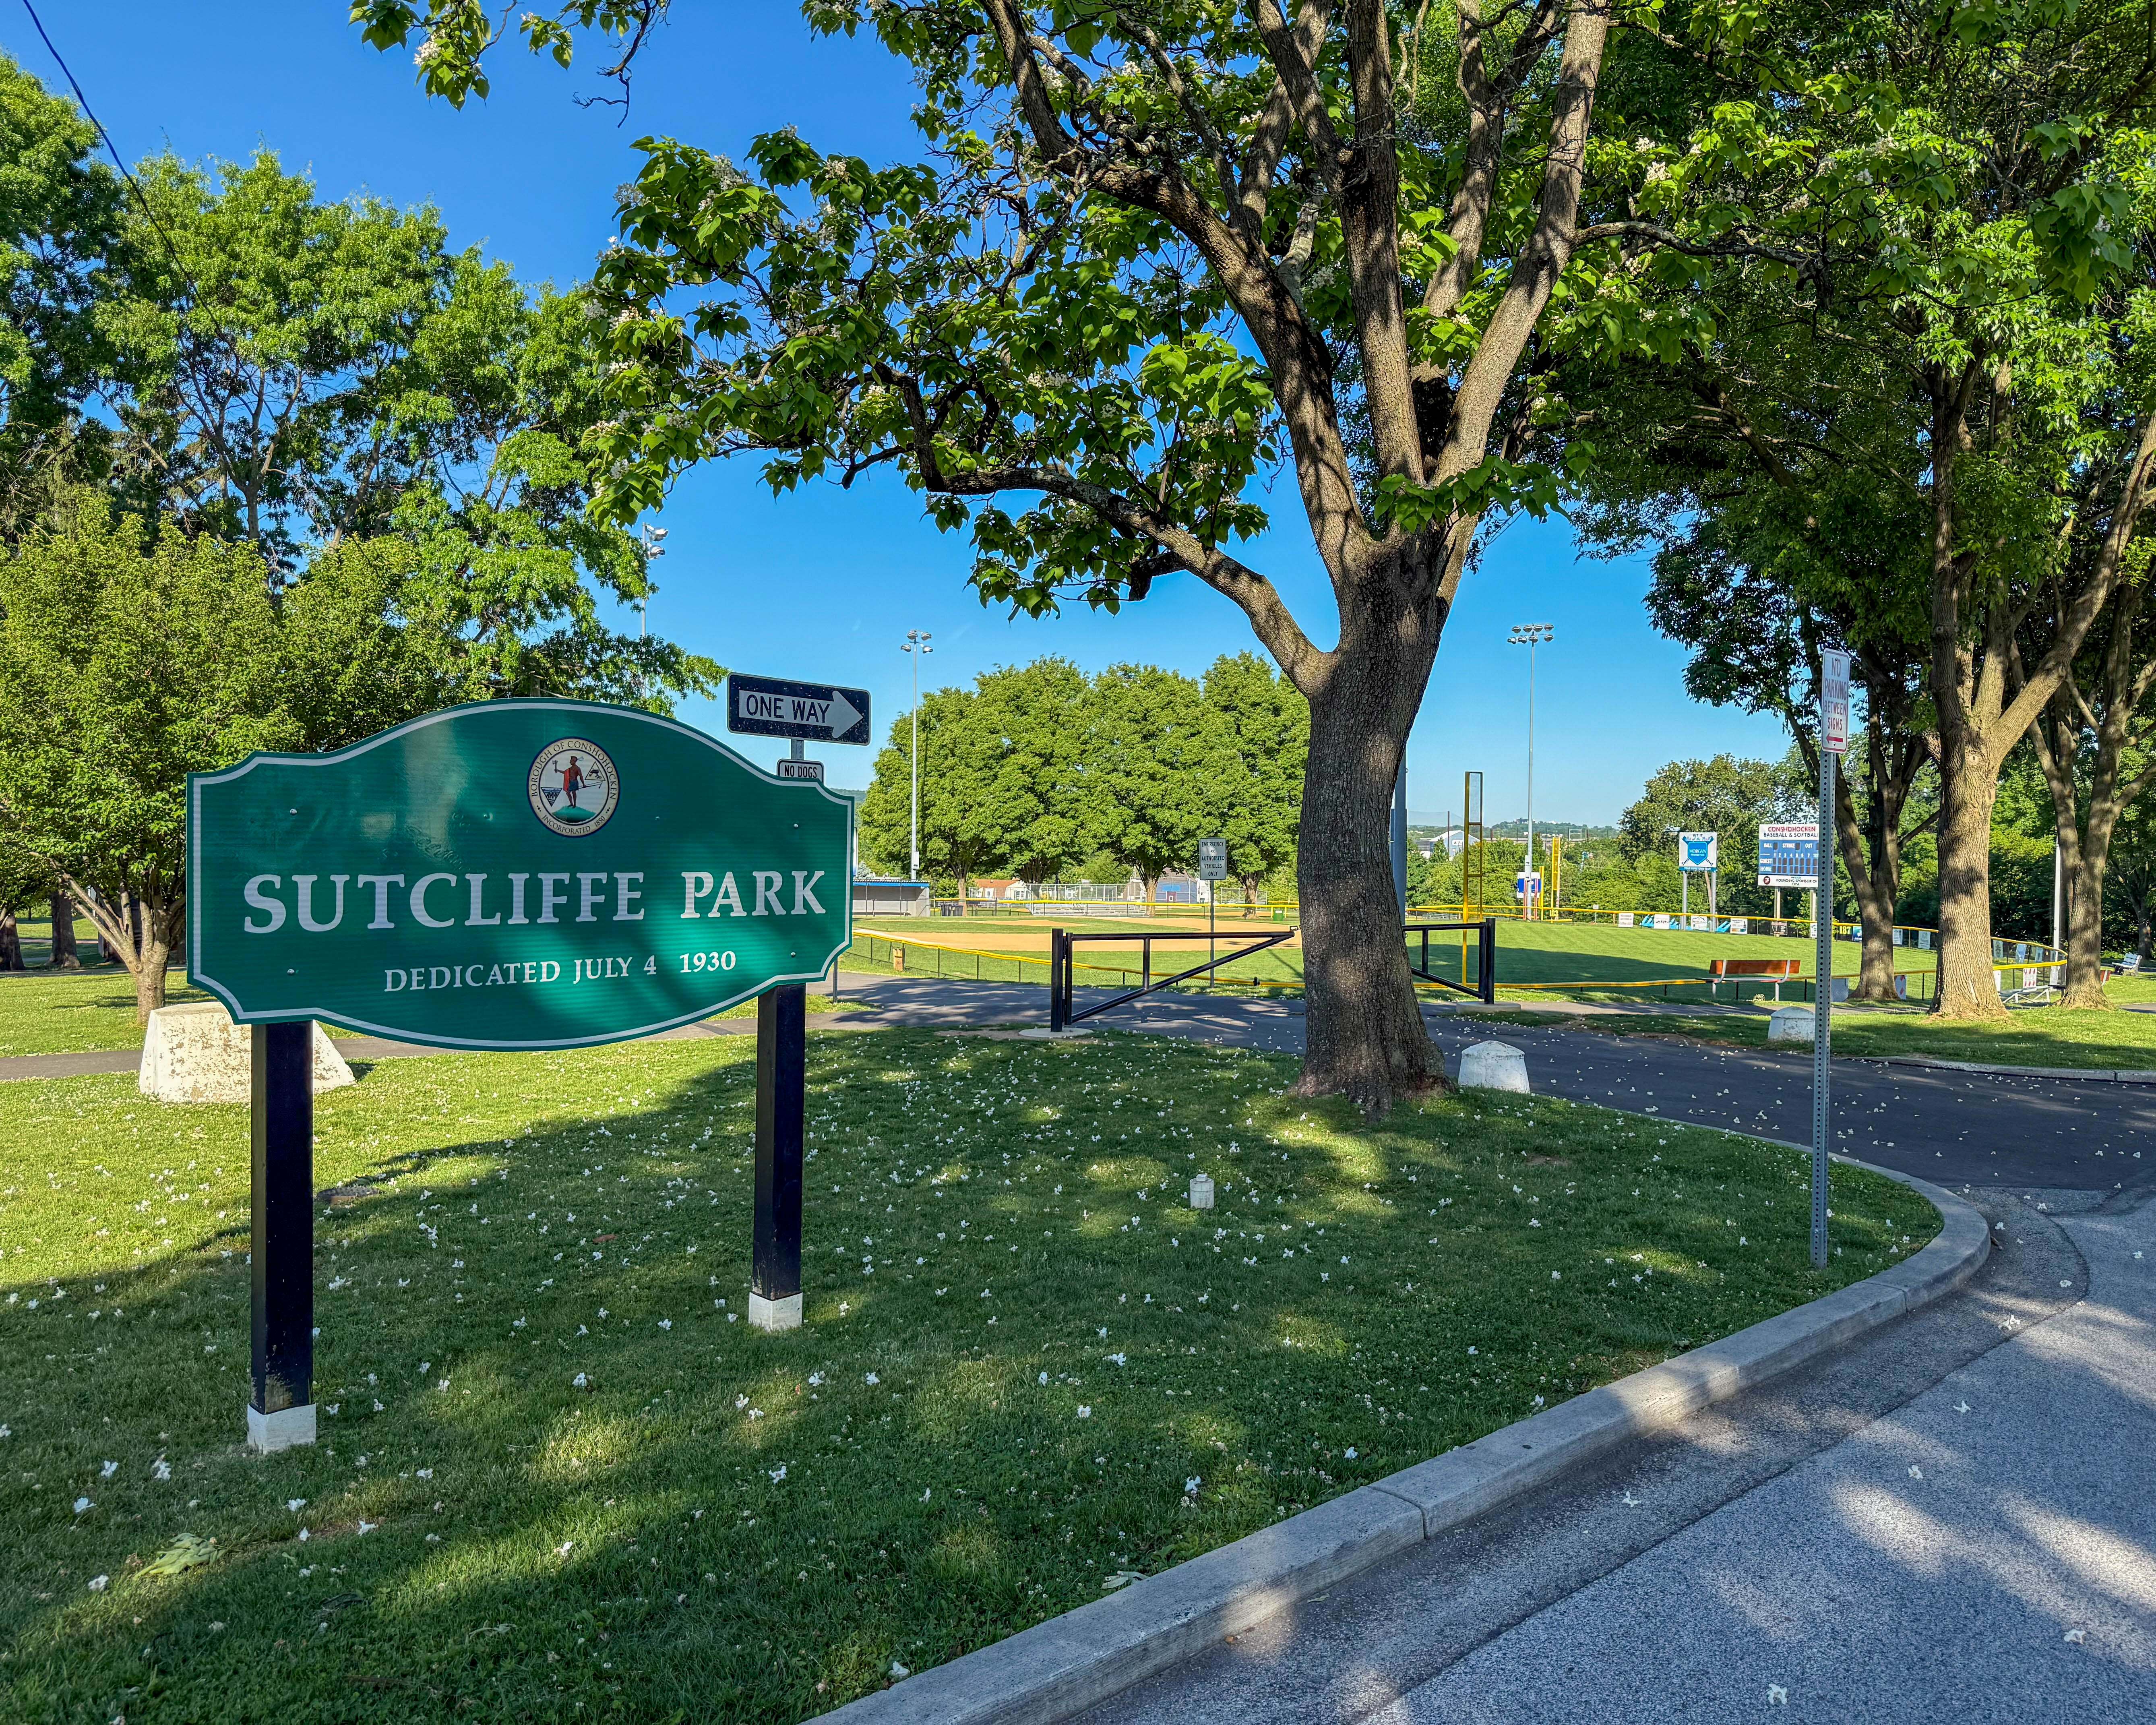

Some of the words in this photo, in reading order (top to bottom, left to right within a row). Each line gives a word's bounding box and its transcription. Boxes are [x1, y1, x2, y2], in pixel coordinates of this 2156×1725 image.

[1831, 657, 1841, 678] NO
[1824, 679, 1847, 701] PARKING
[746, 694, 784, 719] ONE
[792, 699, 830, 723] WAY
[1824, 700, 1846, 715] BETWEEN
[1827, 718, 1843, 731] SIGNS
[531, 750, 552, 796] BOROUGH
[554, 742, 565, 752] OF
[567, 740, 616, 800] CONSHOHOCKEN
[785, 765, 795, 777] NO
[798, 766, 817, 778] DOGS
[542, 814, 591, 835] INCORPORATED
[594, 815, 606, 827] 1850
[244, 873, 645, 934] SUTCLIFFE
[680, 871, 827, 918] PARK
[1840, 925, 1851, 935] 187
[384, 961, 560, 992] DEDICATED
[573, 956, 633, 984] JULY
[643, 955, 657, 975] 4
[679, 951, 736, 973] 1930
